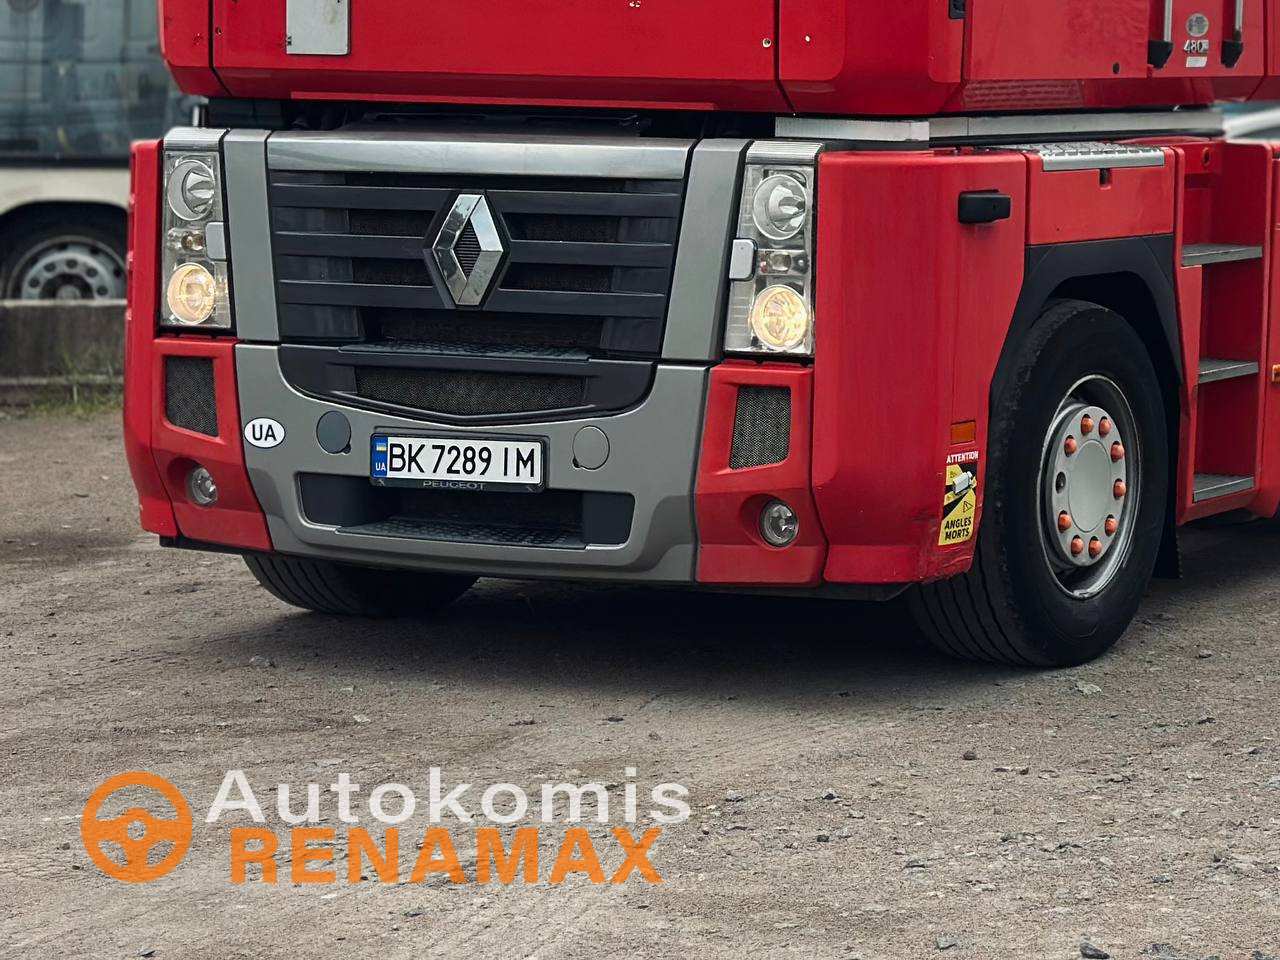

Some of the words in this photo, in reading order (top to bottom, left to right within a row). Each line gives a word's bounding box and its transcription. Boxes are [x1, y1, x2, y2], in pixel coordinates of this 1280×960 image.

[252, 423, 277, 441] UA
[389, 443, 425, 473] BK
[432, 444, 492, 475] 7289
[503, 447, 535, 477] IM
[946, 451, 979, 464] ATTENTION
[376, 463, 386, 472] UA
[423, 480, 486, 490] PEUGEOT
[944, 516, 972, 530] ANGLES
[945, 527, 970, 541] MORTS
